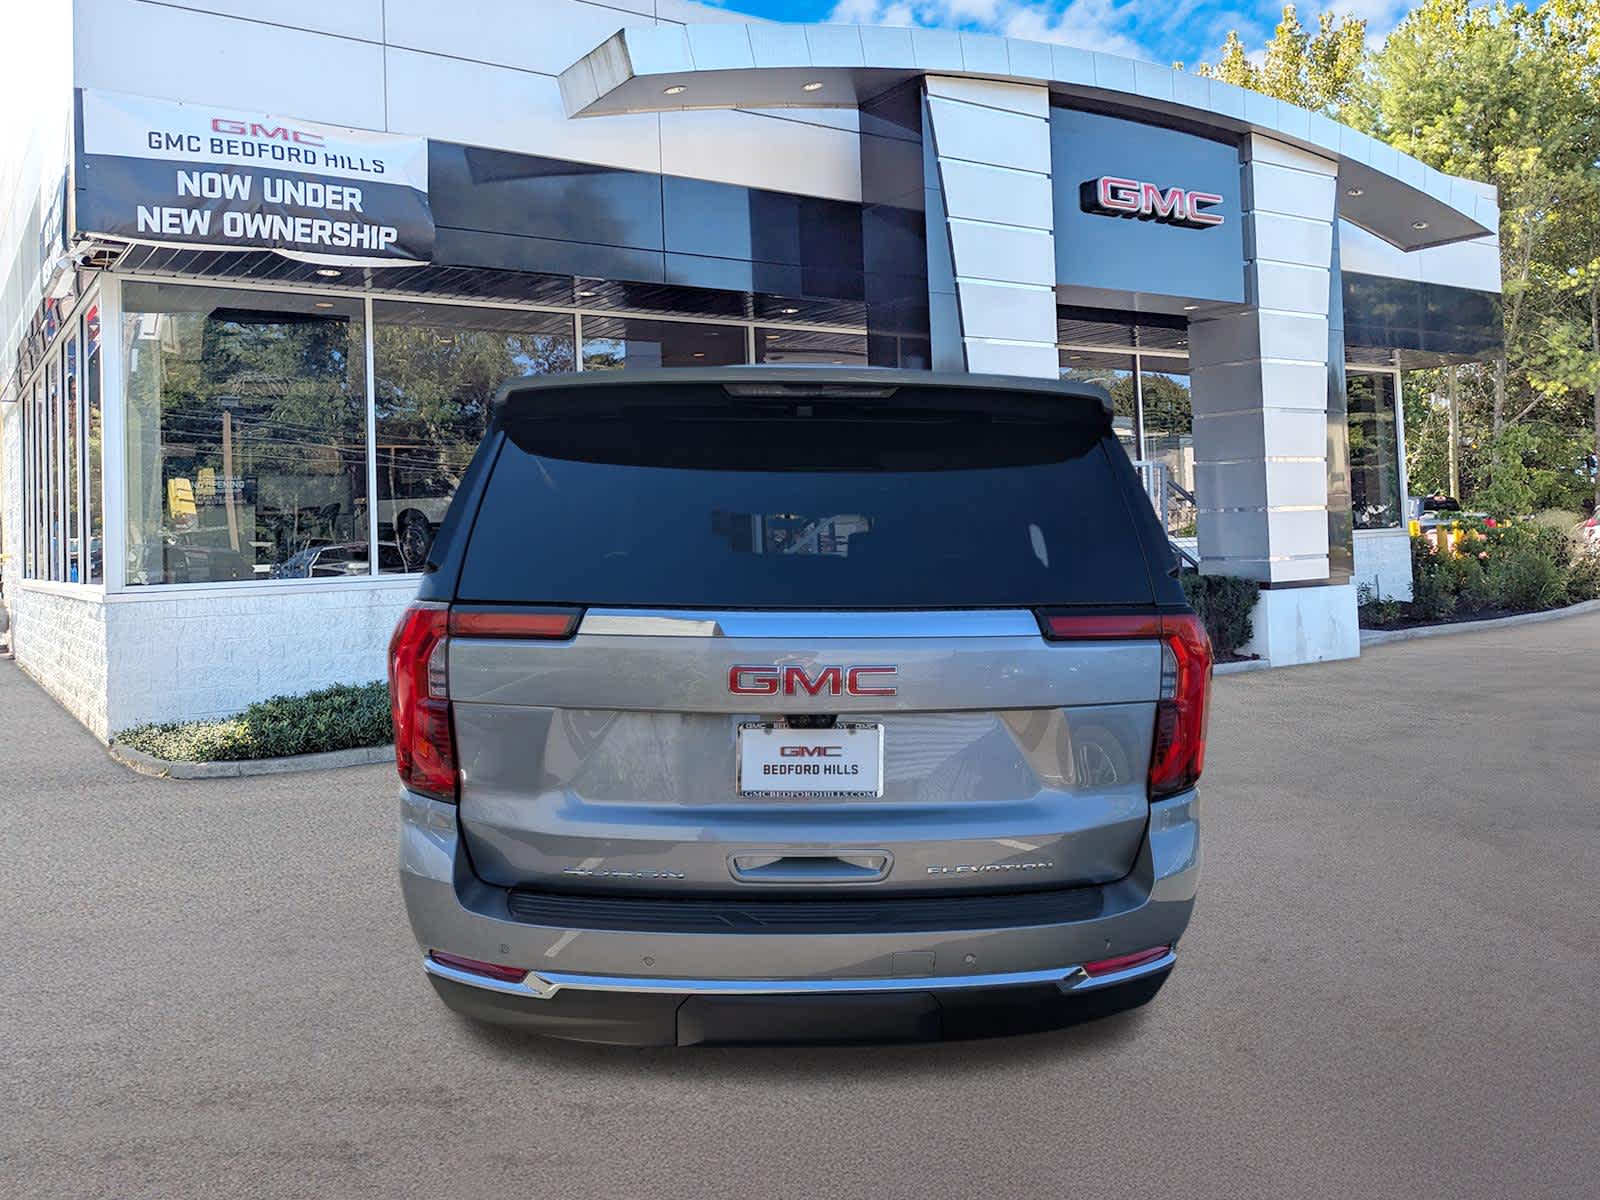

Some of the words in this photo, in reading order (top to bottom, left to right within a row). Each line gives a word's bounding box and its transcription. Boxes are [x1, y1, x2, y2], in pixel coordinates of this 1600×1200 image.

[211, 118, 326, 147] GMC
[148, 131, 201, 153] GMC
[210, 138, 316, 166] BEDFORD
[324, 153, 385, 174] HILLS
[177, 170, 252, 201] NOW
[263, 176, 363, 213] UNDER
[1096, 176, 1225, 225] GMC
[137, 205, 212, 235] NEW
[223, 211, 398, 250] OWNERSHIP
[728, 665, 898, 697] GMC
[780, 746, 843, 758] GMC
[763, 764, 820, 776] BEDFORD
[823, 764, 859, 776] HILLS
[927, 862, 1056, 875] ELEVATION
